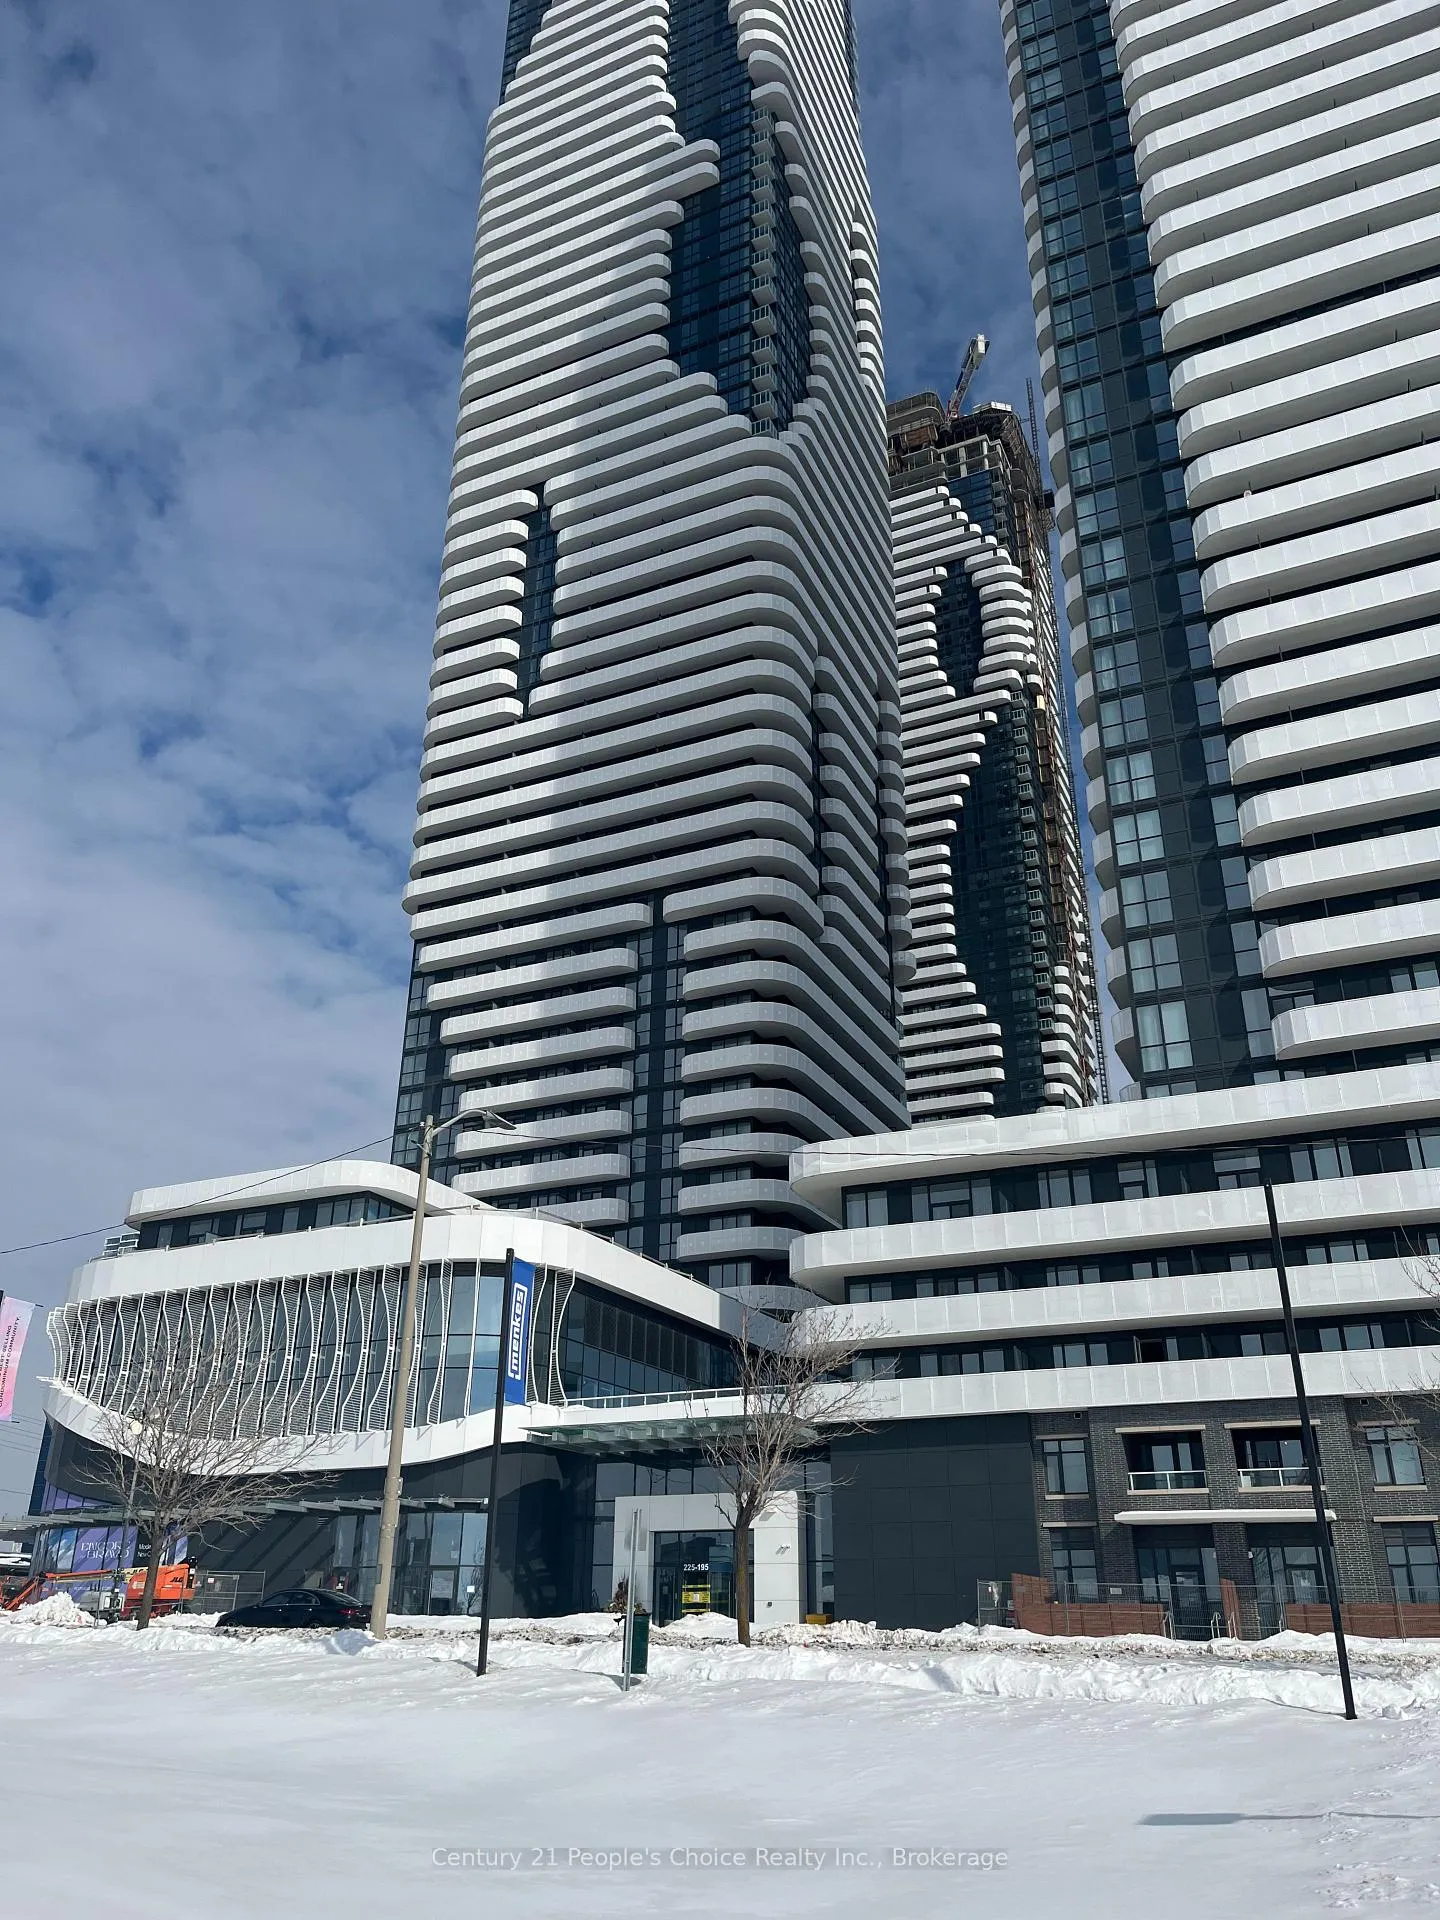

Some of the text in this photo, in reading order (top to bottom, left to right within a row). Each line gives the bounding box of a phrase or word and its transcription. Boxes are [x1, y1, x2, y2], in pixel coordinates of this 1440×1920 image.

[510, 1290, 525, 1371] menkes
[0, 1358, 10, 1406] CONDOMINIUM
[683, 1563, 709, 1571] 225-195
